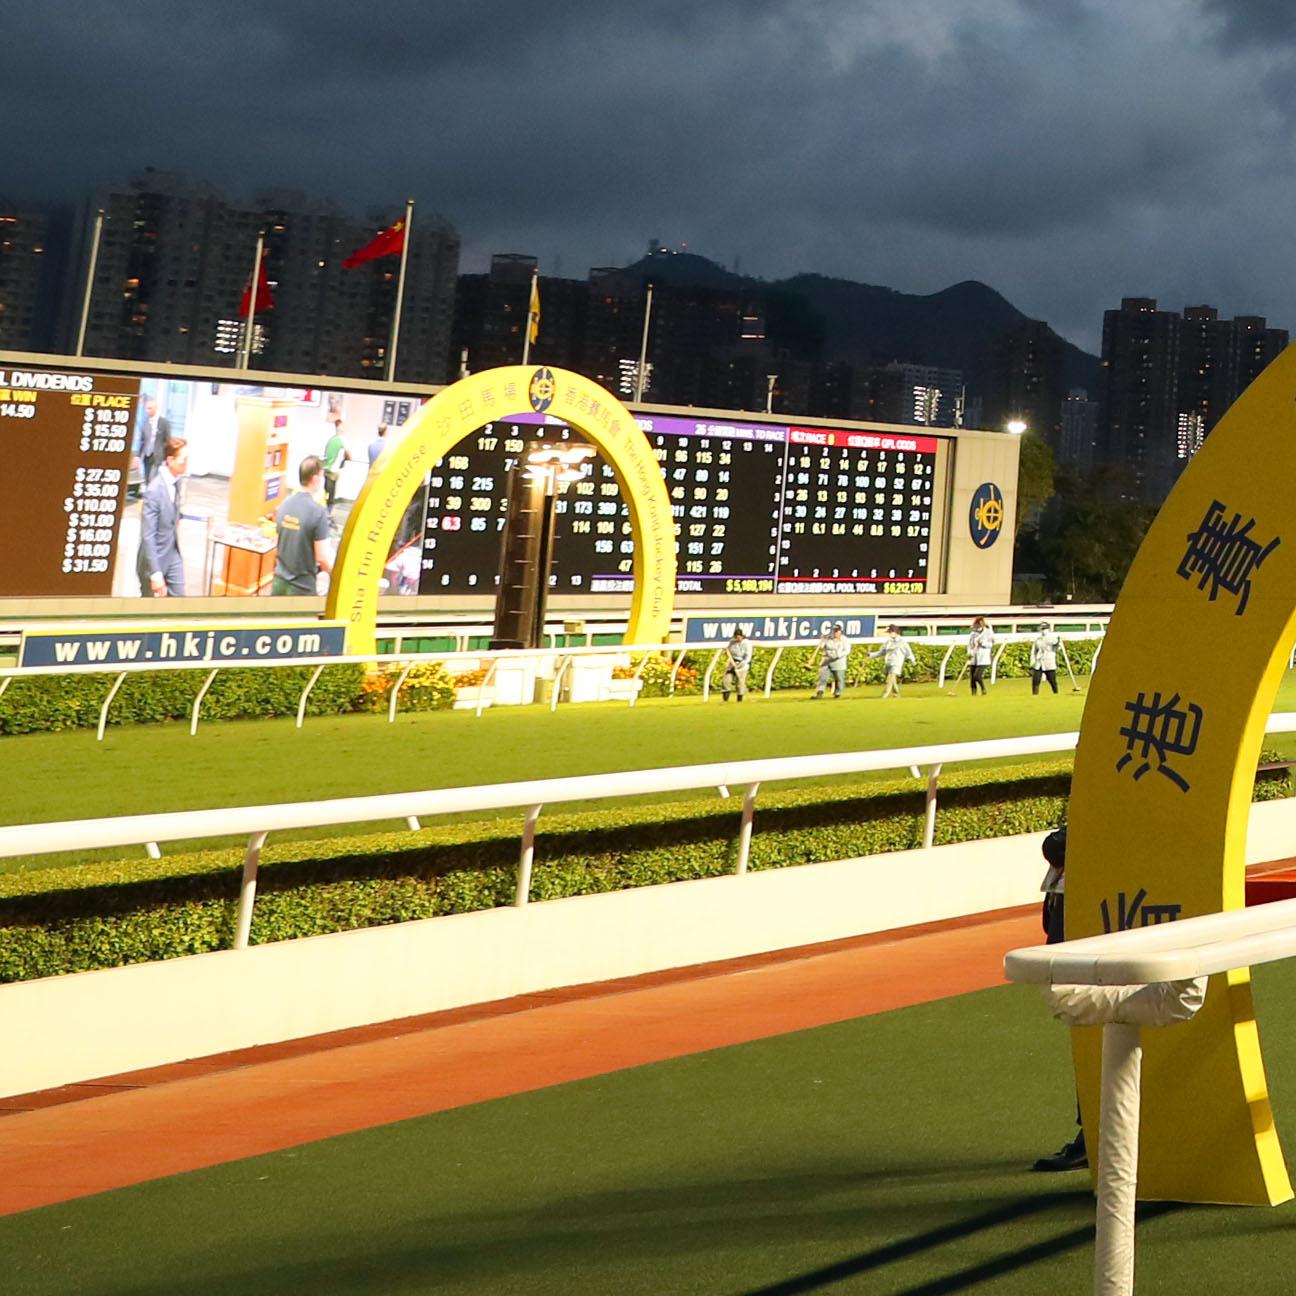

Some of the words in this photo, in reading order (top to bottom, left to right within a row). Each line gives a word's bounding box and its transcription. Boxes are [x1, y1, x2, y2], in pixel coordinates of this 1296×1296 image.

[11, 371, 93, 392] DIVIDENDS
[13, 390, 37, 403] WIN
[92, 396, 131, 408] PLACE
[484, 424, 493, 435] 2
[511, 426, 519, 436] 3
[536, 427, 544, 437] 4
[562, 429, 569, 439] 5
[478, 437, 498, 451] 117
[657, 436, 664, 446] 9
[700, 439, 710, 448] 11
[722, 441, 732, 450] 12
[696, 452, 713, 464] 115
[803, 446, 808, 455] 1
[823, 447, 829, 456] 2
[842, 449, 848, 457] 3
[861, 450, 867, 458] 4
[880, 451, 886, 460] 5
[898, 452, 904, 461] 6
[916, 454, 922, 462] 7
[820, 458, 830, 469] 12
[877, 461, 887, 473] 17
[914, 464, 924, 475] 12
[673, 468, 687, 480] 47
[719, 471, 731, 483] 14
[775, 474, 782, 484] 2
[817, 474, 828, 485] 71
[472, 477, 494, 491] 215
[367, 444, 428, 543] Racecourse
[774, 492, 780, 502] 3
[429, 497, 440, 508] 11
[574, 502, 593, 514] 173
[689, 505, 707, 518] 421
[772, 510, 778, 519] 4
[834, 507, 846, 519] 27
[922, 512, 929, 521] 11
[427, 518, 438, 528] 12
[572, 521, 591, 533] 114
[689, 523, 706, 536] 127
[712, 524, 725, 537] 22
[771, 528, 777, 537] 5
[795, 523, 805, 534] 11
[711, 542, 724, 555] 27
[769, 546, 776, 555] 6
[357, 551, 374, 577] Tin
[686, 561, 703, 573] 115
[769, 562, 775, 572] 7
[442, 575, 450, 586] 8
[468, 575, 477, 586] 9
[794, 569, 799, 578] 1
[813, 569, 819, 578] 2
[833, 569, 839, 578] 3
[852, 569, 858, 578] 4
[871, 569, 877, 578] 5
[890, 569, 896, 578] 6
[908, 569, 914, 578] 7
[678, 581, 703, 591] TOTAL
[351, 587, 365, 622] Sha
[55, 632, 321, 662] www.hkjc.com
